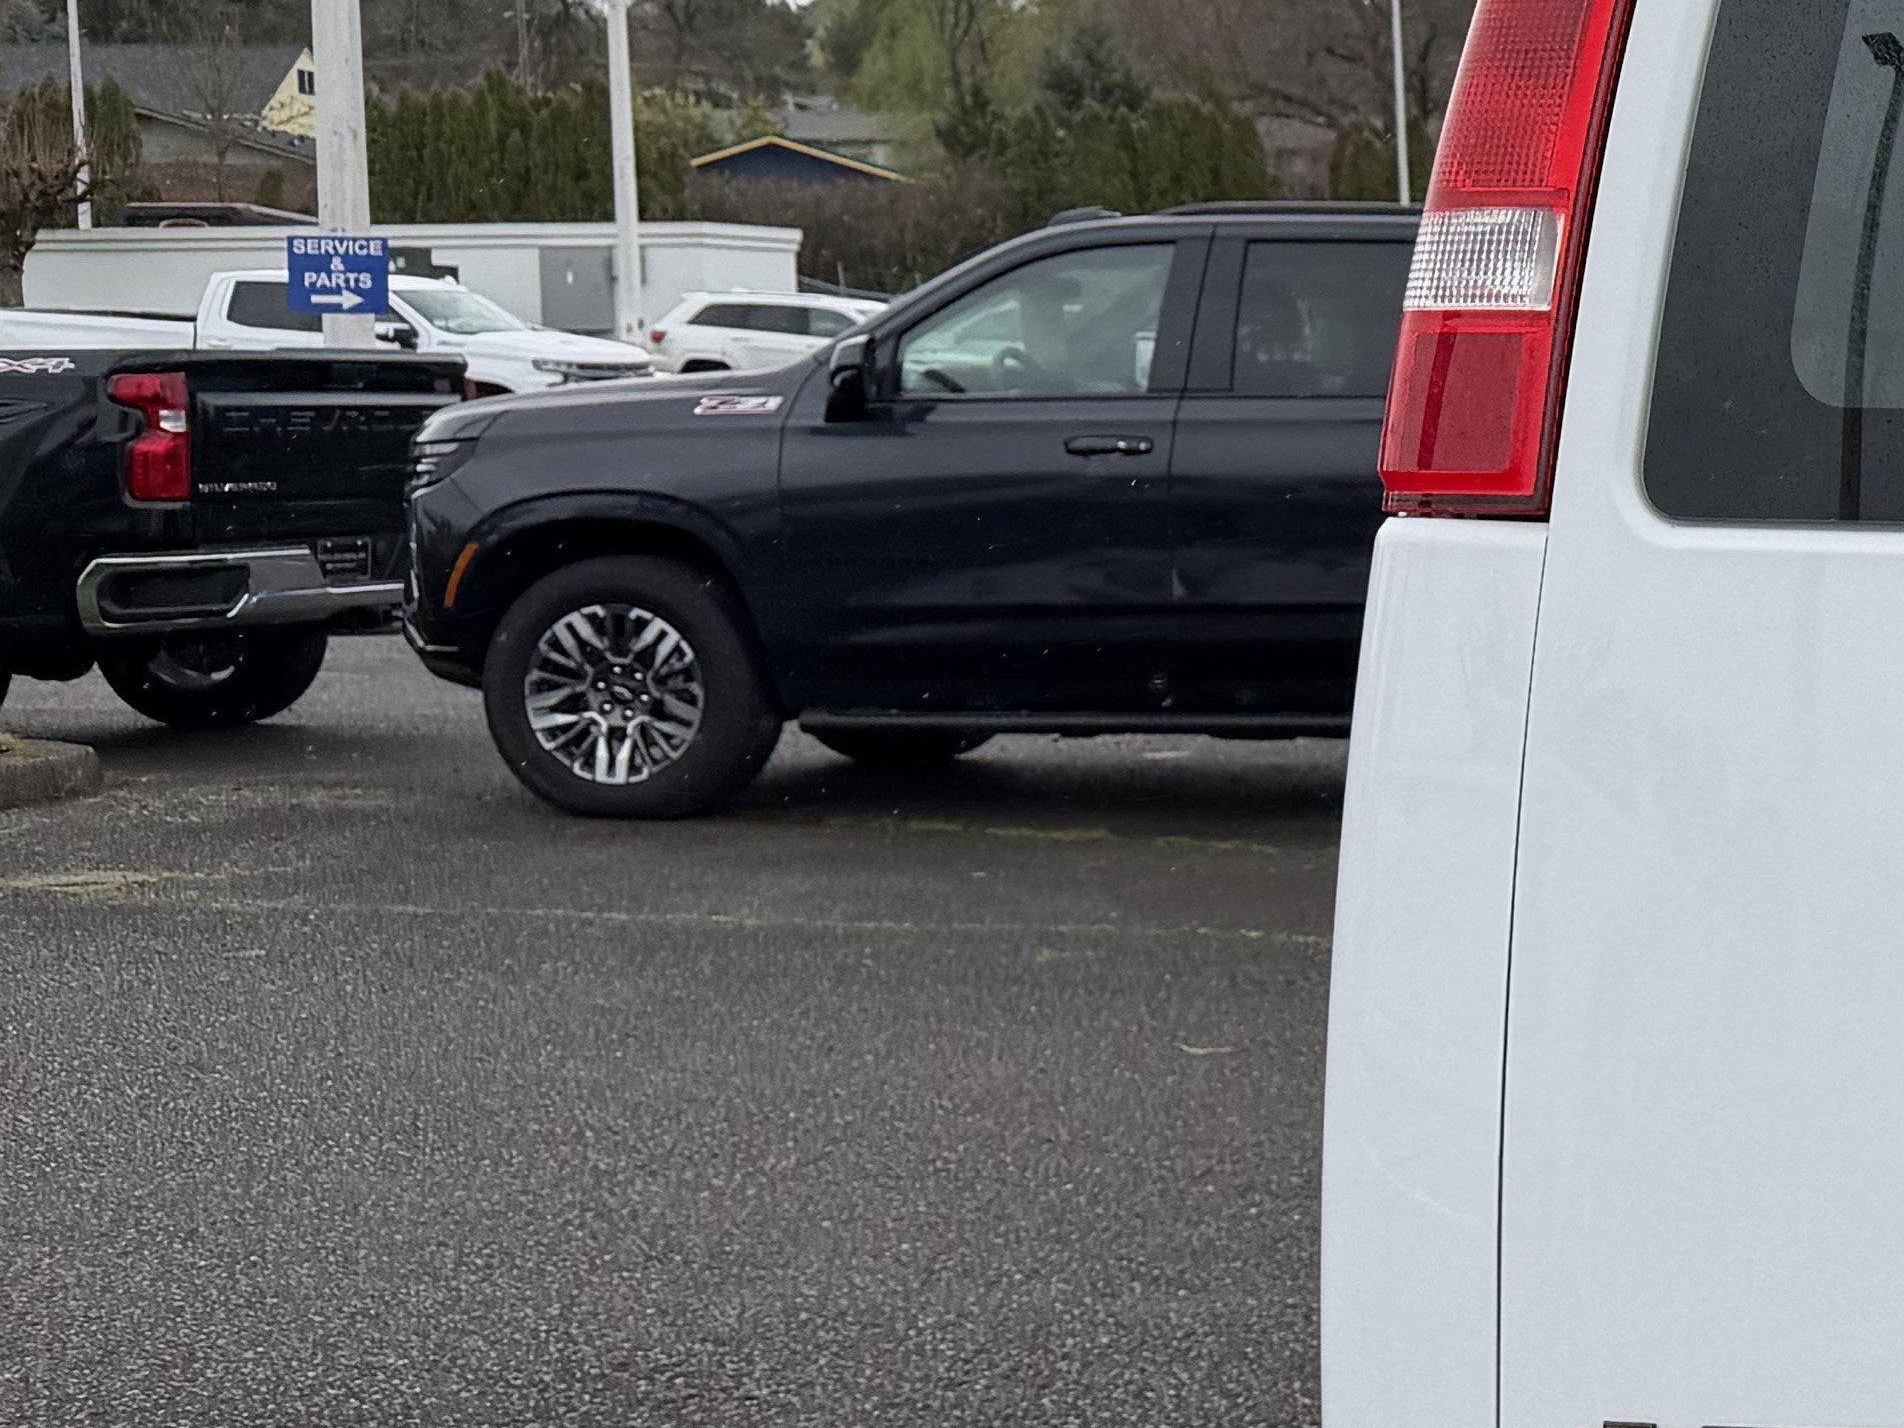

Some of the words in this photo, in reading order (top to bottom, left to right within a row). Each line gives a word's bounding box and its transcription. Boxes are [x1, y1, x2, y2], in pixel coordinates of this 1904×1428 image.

[293, 239, 383, 256] SERVICE
[331, 256, 345, 271] &
[304, 272, 372, 289] PARTS
